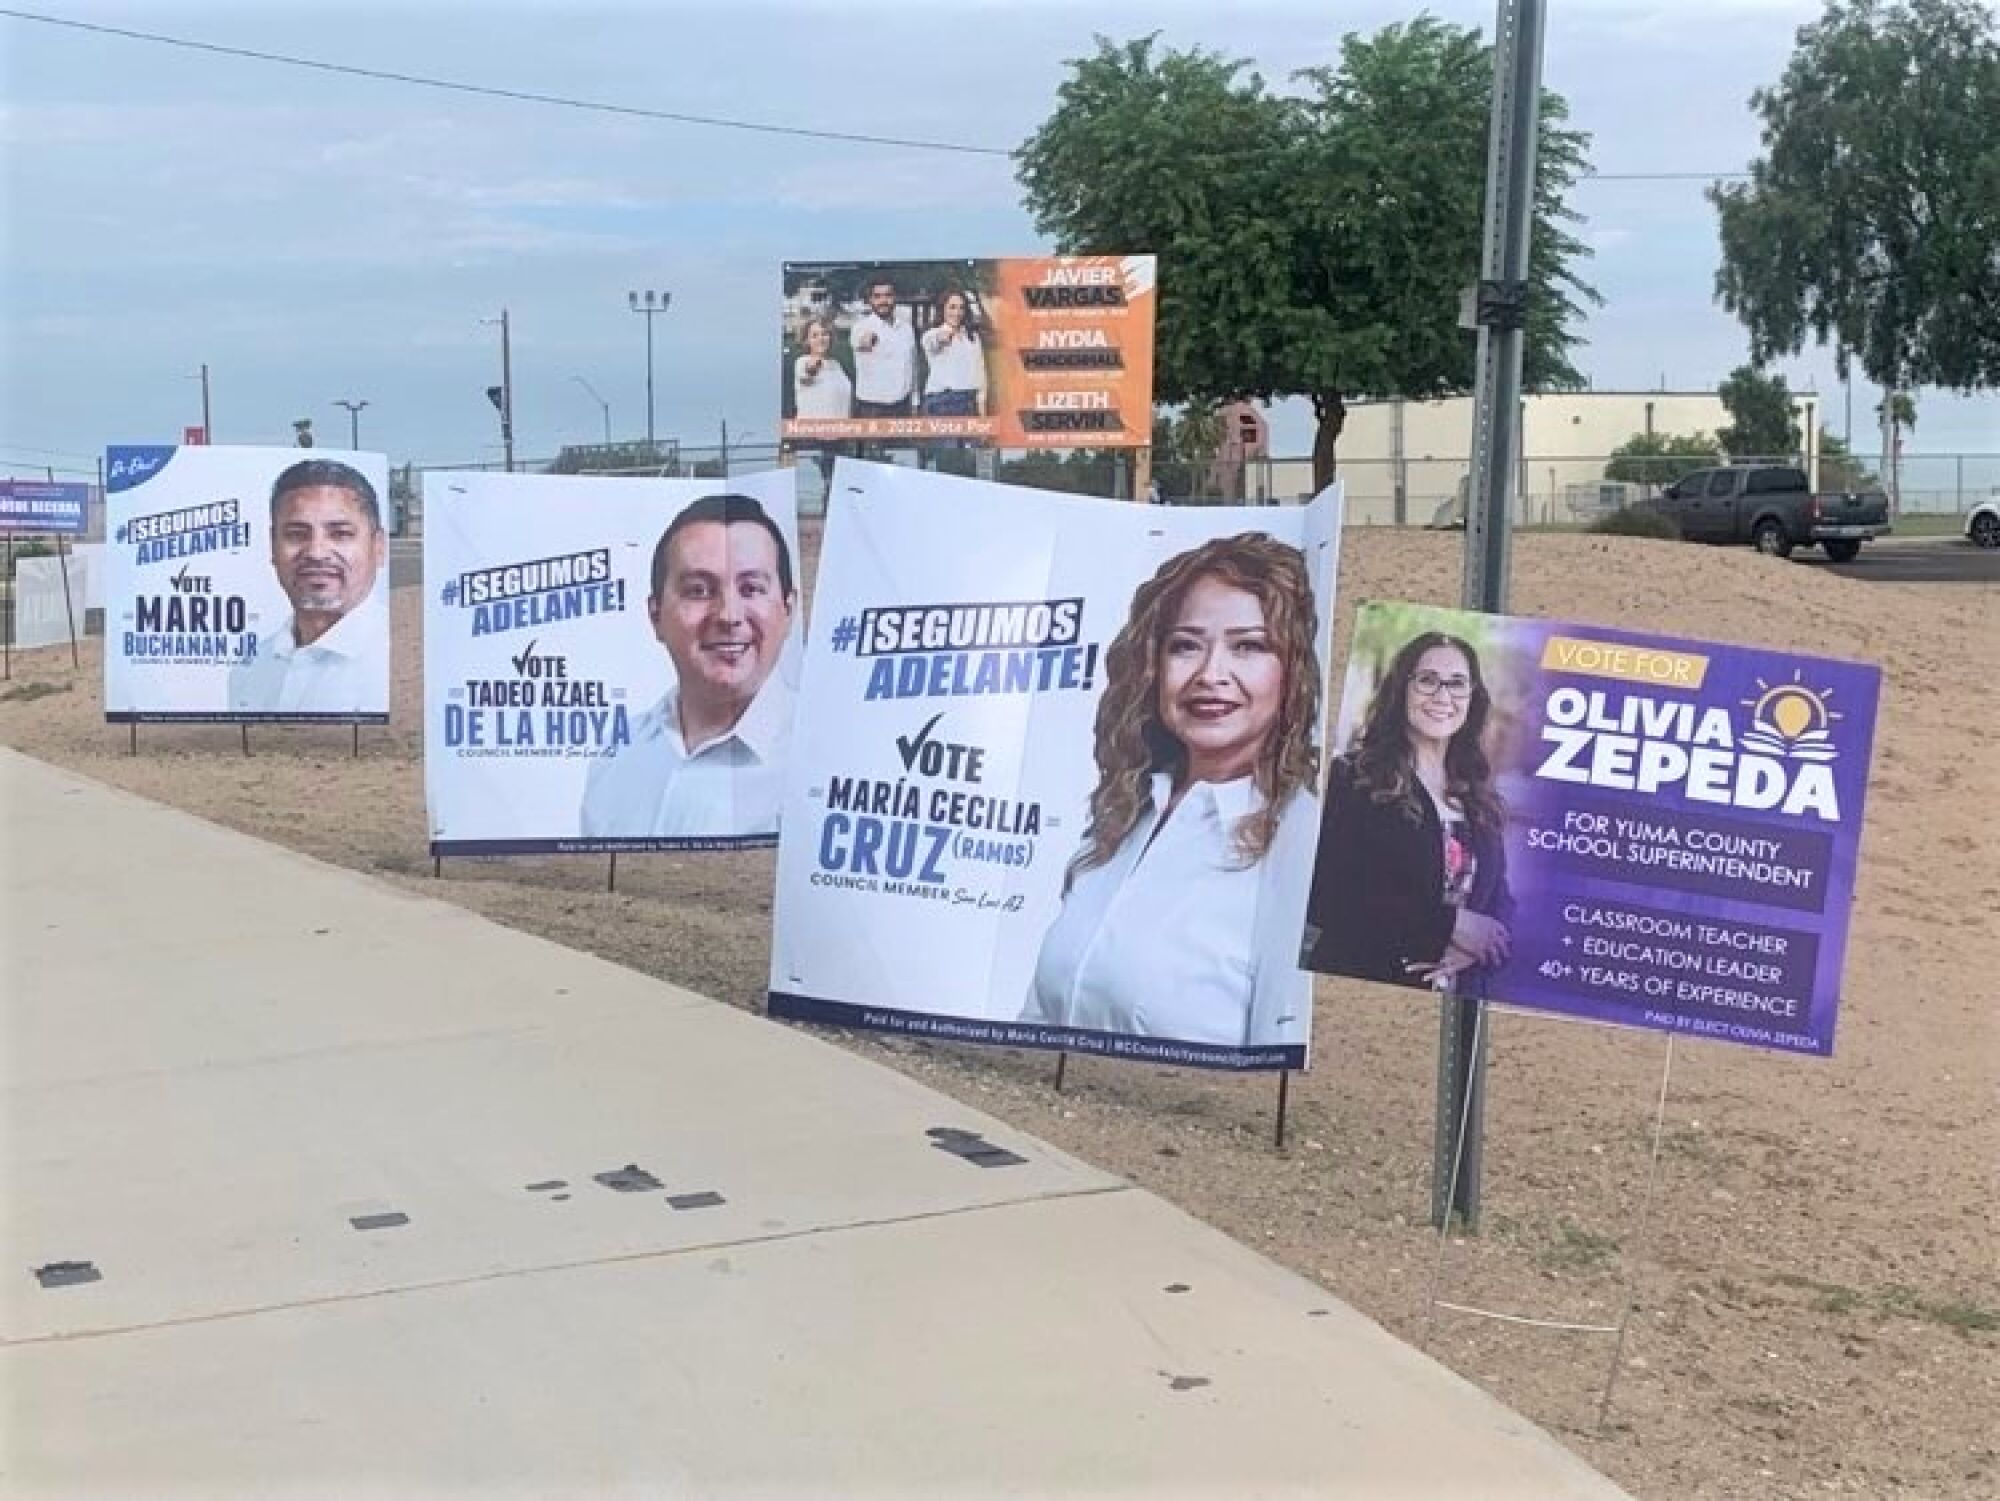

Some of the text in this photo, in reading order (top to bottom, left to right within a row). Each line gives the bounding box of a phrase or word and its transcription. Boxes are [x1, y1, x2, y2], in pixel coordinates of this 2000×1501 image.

[1026, 287, 1122, 306] VARGAS
[1042, 267, 1116, 285] JAVIER
[1040, 329, 1107, 347] NYDIA
[1036, 391, 1109, 408] LIZETH
[136, 522, 249, 565] ADELANTE!
[170, 564, 212, 593] VOTE
[136, 595, 246, 632] MARIO
[472, 578, 625, 637] ADELANTE!
[123, 632, 257, 656] BUCHANAN JR
[512, 639, 567, 678] VOTE
[1558, 644, 1690, 681] VOTE FOR
[466, 680, 609, 707] TADEO AZAEL
[864, 643, 1099, 701] ADELANTE!
[445, 704, 631, 747] DE LA HOYA
[1547, 688, 1734, 747] OLIVIA
[896, 712, 985, 784] VOTE
[1535, 724, 1841, 821] ZEPEDA
[827, 775, 1041, 835] MARÍA CECILIA
[819, 812, 1035, 884] CRUZ (RAMOS)
[1565, 810, 1782, 860] FOR YUMA COUNTY
[1527, 828, 1814, 889] SCHOOL SUPERINTENDENT
[810, 871, 878, 892] COUNCIL
[883, 880, 950, 900] MEMBER
[1563, 903, 1788, 955] CLASSROOM TEACHER
[1583, 935, 1702, 971] EDUCATION
[1705, 956, 1783, 984] LEADER
[1538, 959, 1798, 1017] 40+ YEARS OF EXPERIENCE
[1645, 1010, 1819, 1049] PAID BY ELECT OLIVIA ZEPEDA
